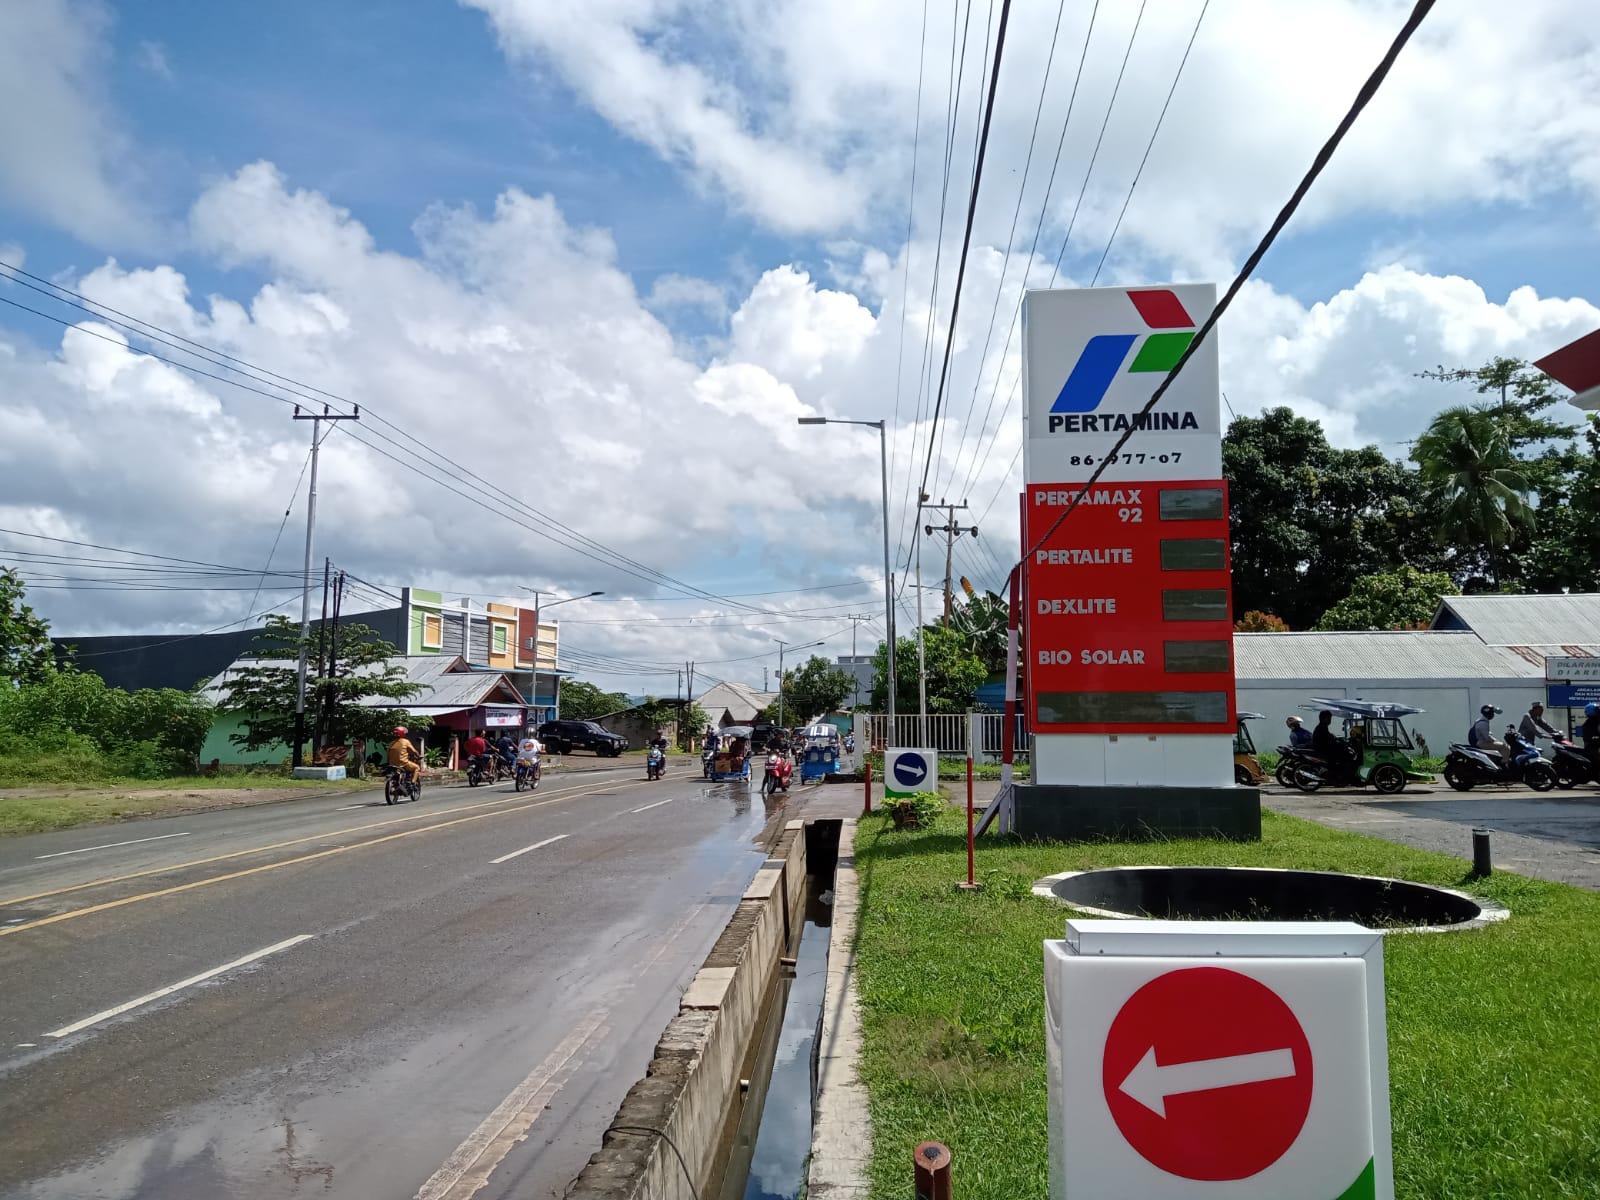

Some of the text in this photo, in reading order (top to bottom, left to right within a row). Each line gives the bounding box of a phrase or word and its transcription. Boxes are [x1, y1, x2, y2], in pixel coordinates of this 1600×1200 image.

[1049, 411, 1199, 433] PERTAMINA
[1070, 452, 1182, 466] 86-977-07
[1035, 490, 1143, 506] PERTAMAX
[1118, 508, 1143, 523] 92
[1036, 548, 1133, 565] PERTALITE
[1037, 598, 1116, 615] DEXLITE
[1038, 649, 1145, 665] BIO SOLAR
